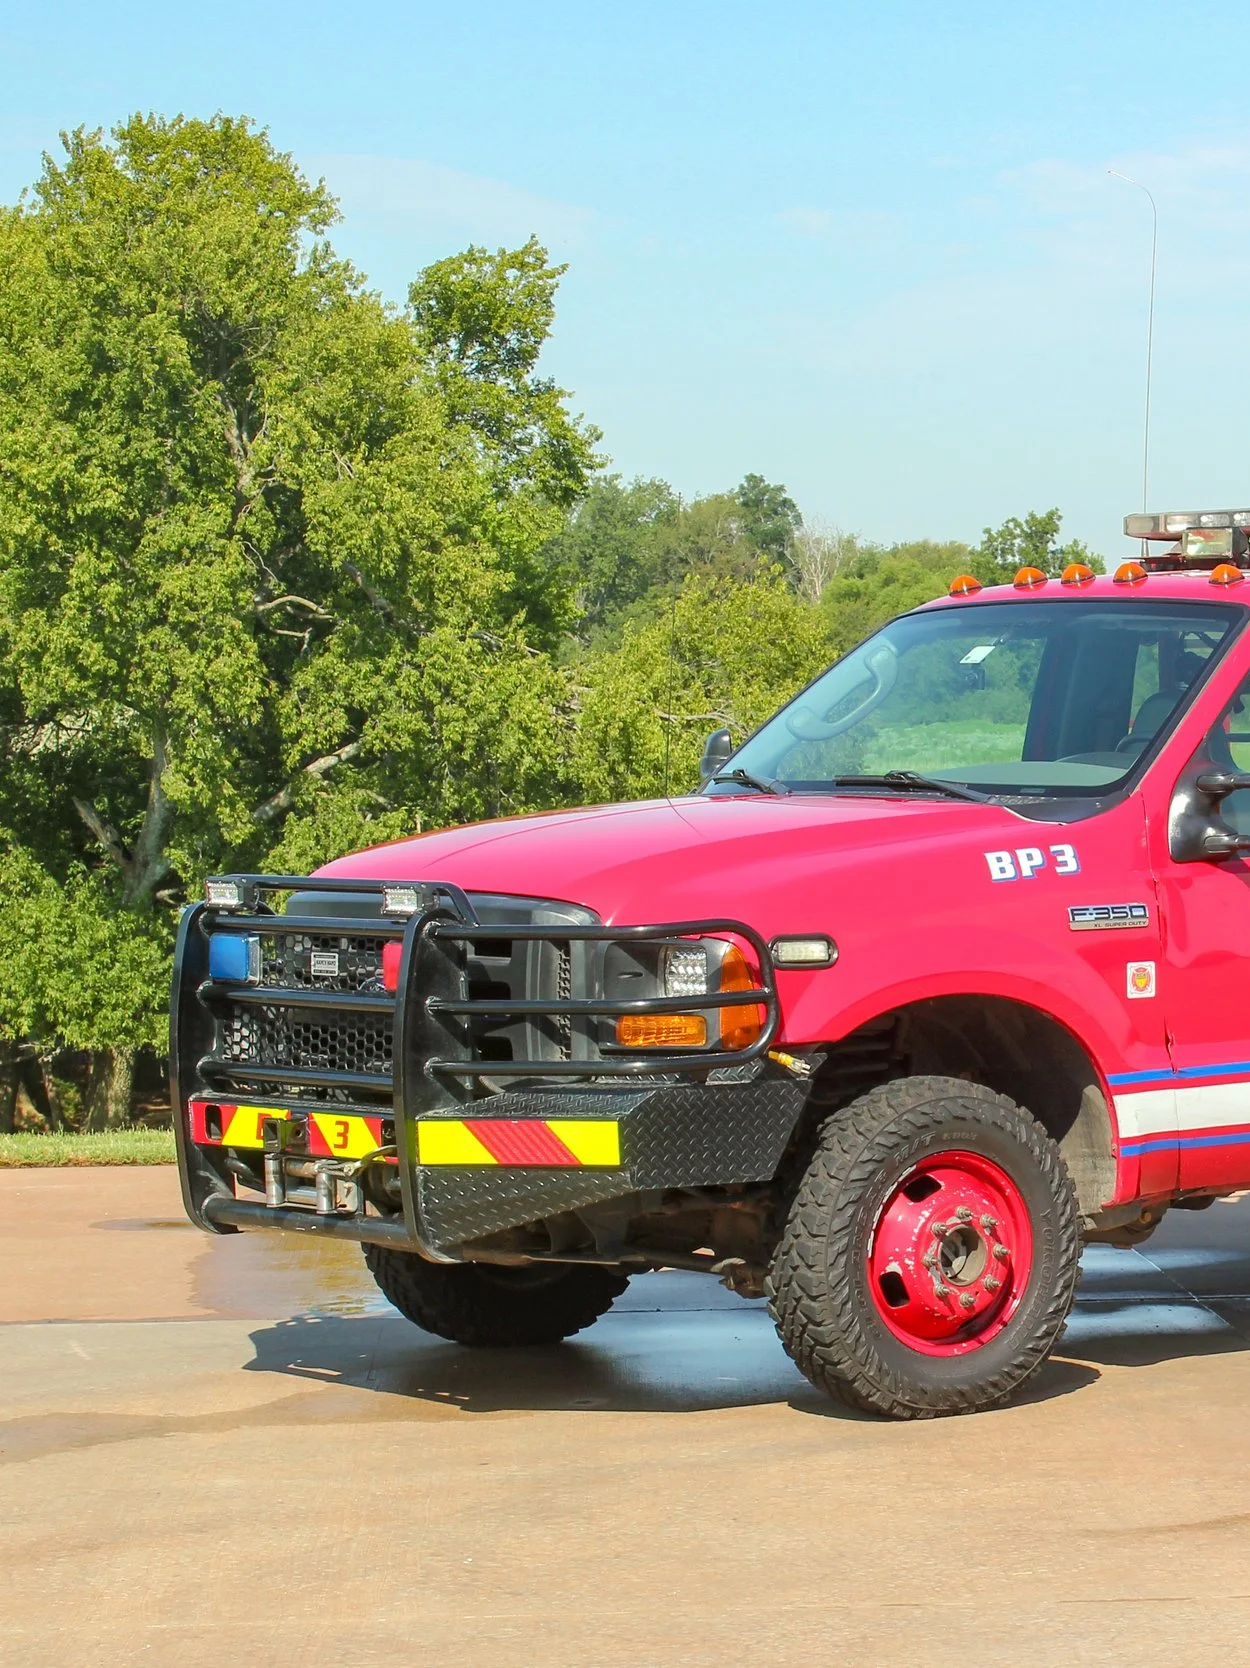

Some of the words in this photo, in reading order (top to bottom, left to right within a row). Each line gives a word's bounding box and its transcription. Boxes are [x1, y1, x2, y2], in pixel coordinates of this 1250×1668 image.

[983, 848, 1048, 882] BP
[1049, 844, 1081, 875] 3
[333, 1120, 350, 1149] 3
